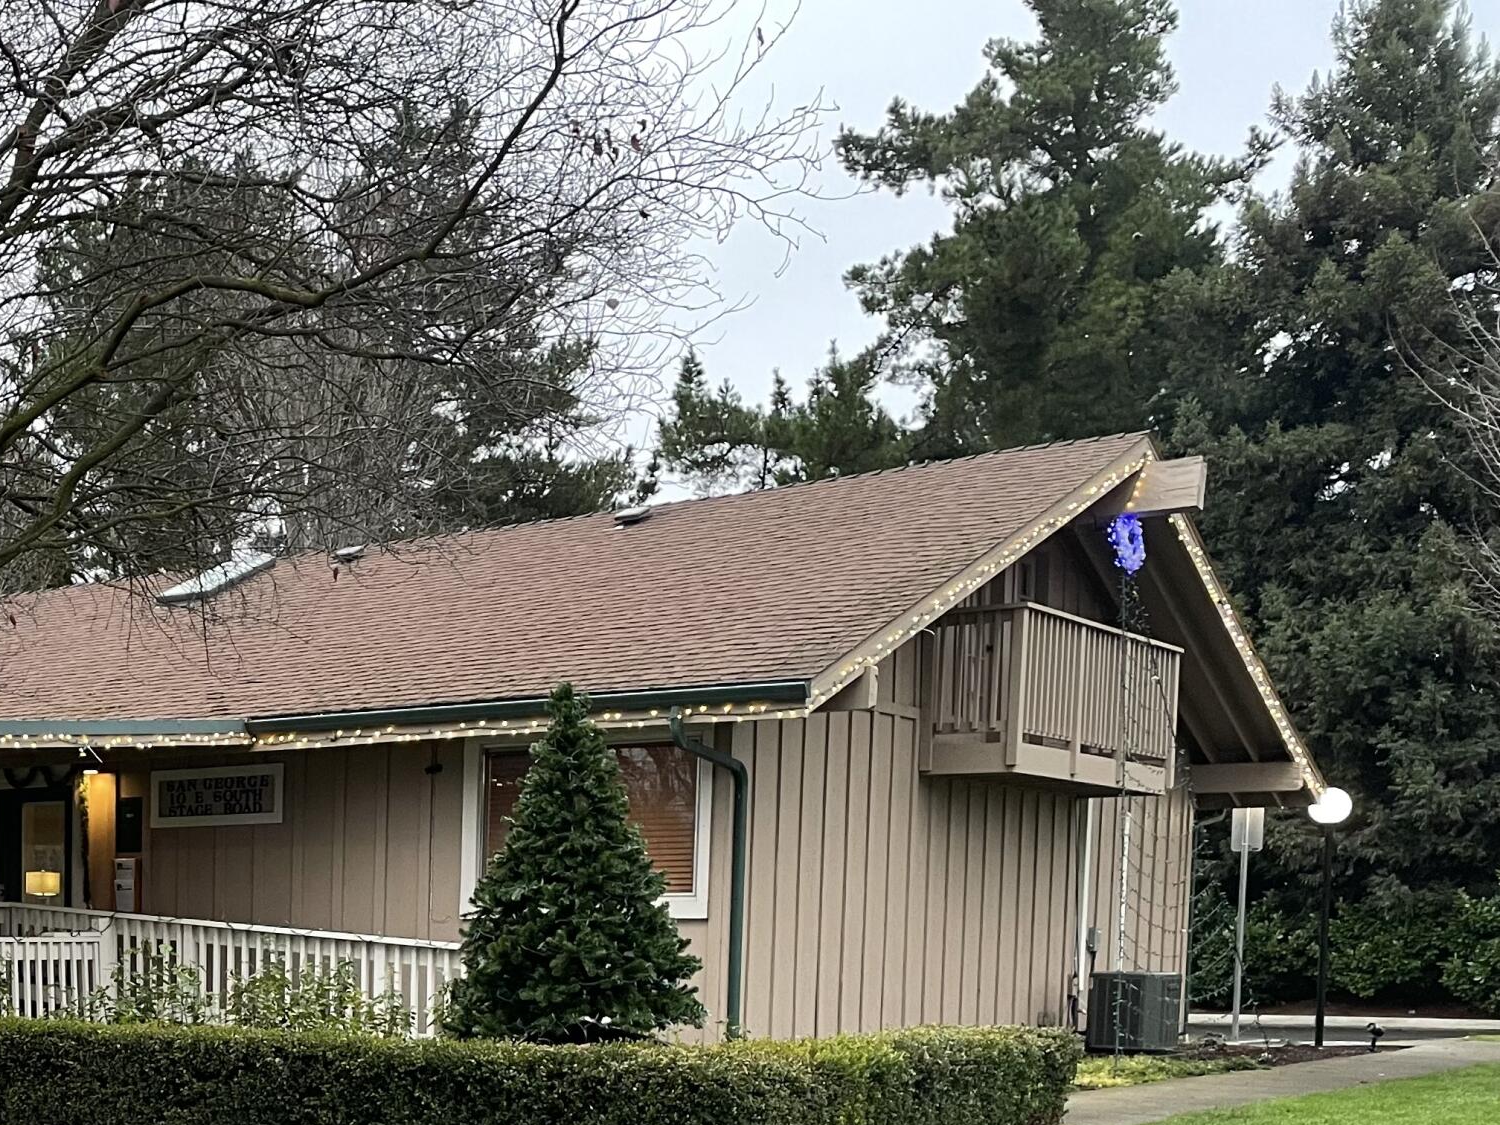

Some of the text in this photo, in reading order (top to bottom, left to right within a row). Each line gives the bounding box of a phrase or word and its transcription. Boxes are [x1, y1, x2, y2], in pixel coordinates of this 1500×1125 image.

[166, 775, 270, 793] SAN GEORGE
[195, 791, 204, 804] E
[213, 788, 263, 803] SOUTH
[168, 804, 213, 818] STAGE
